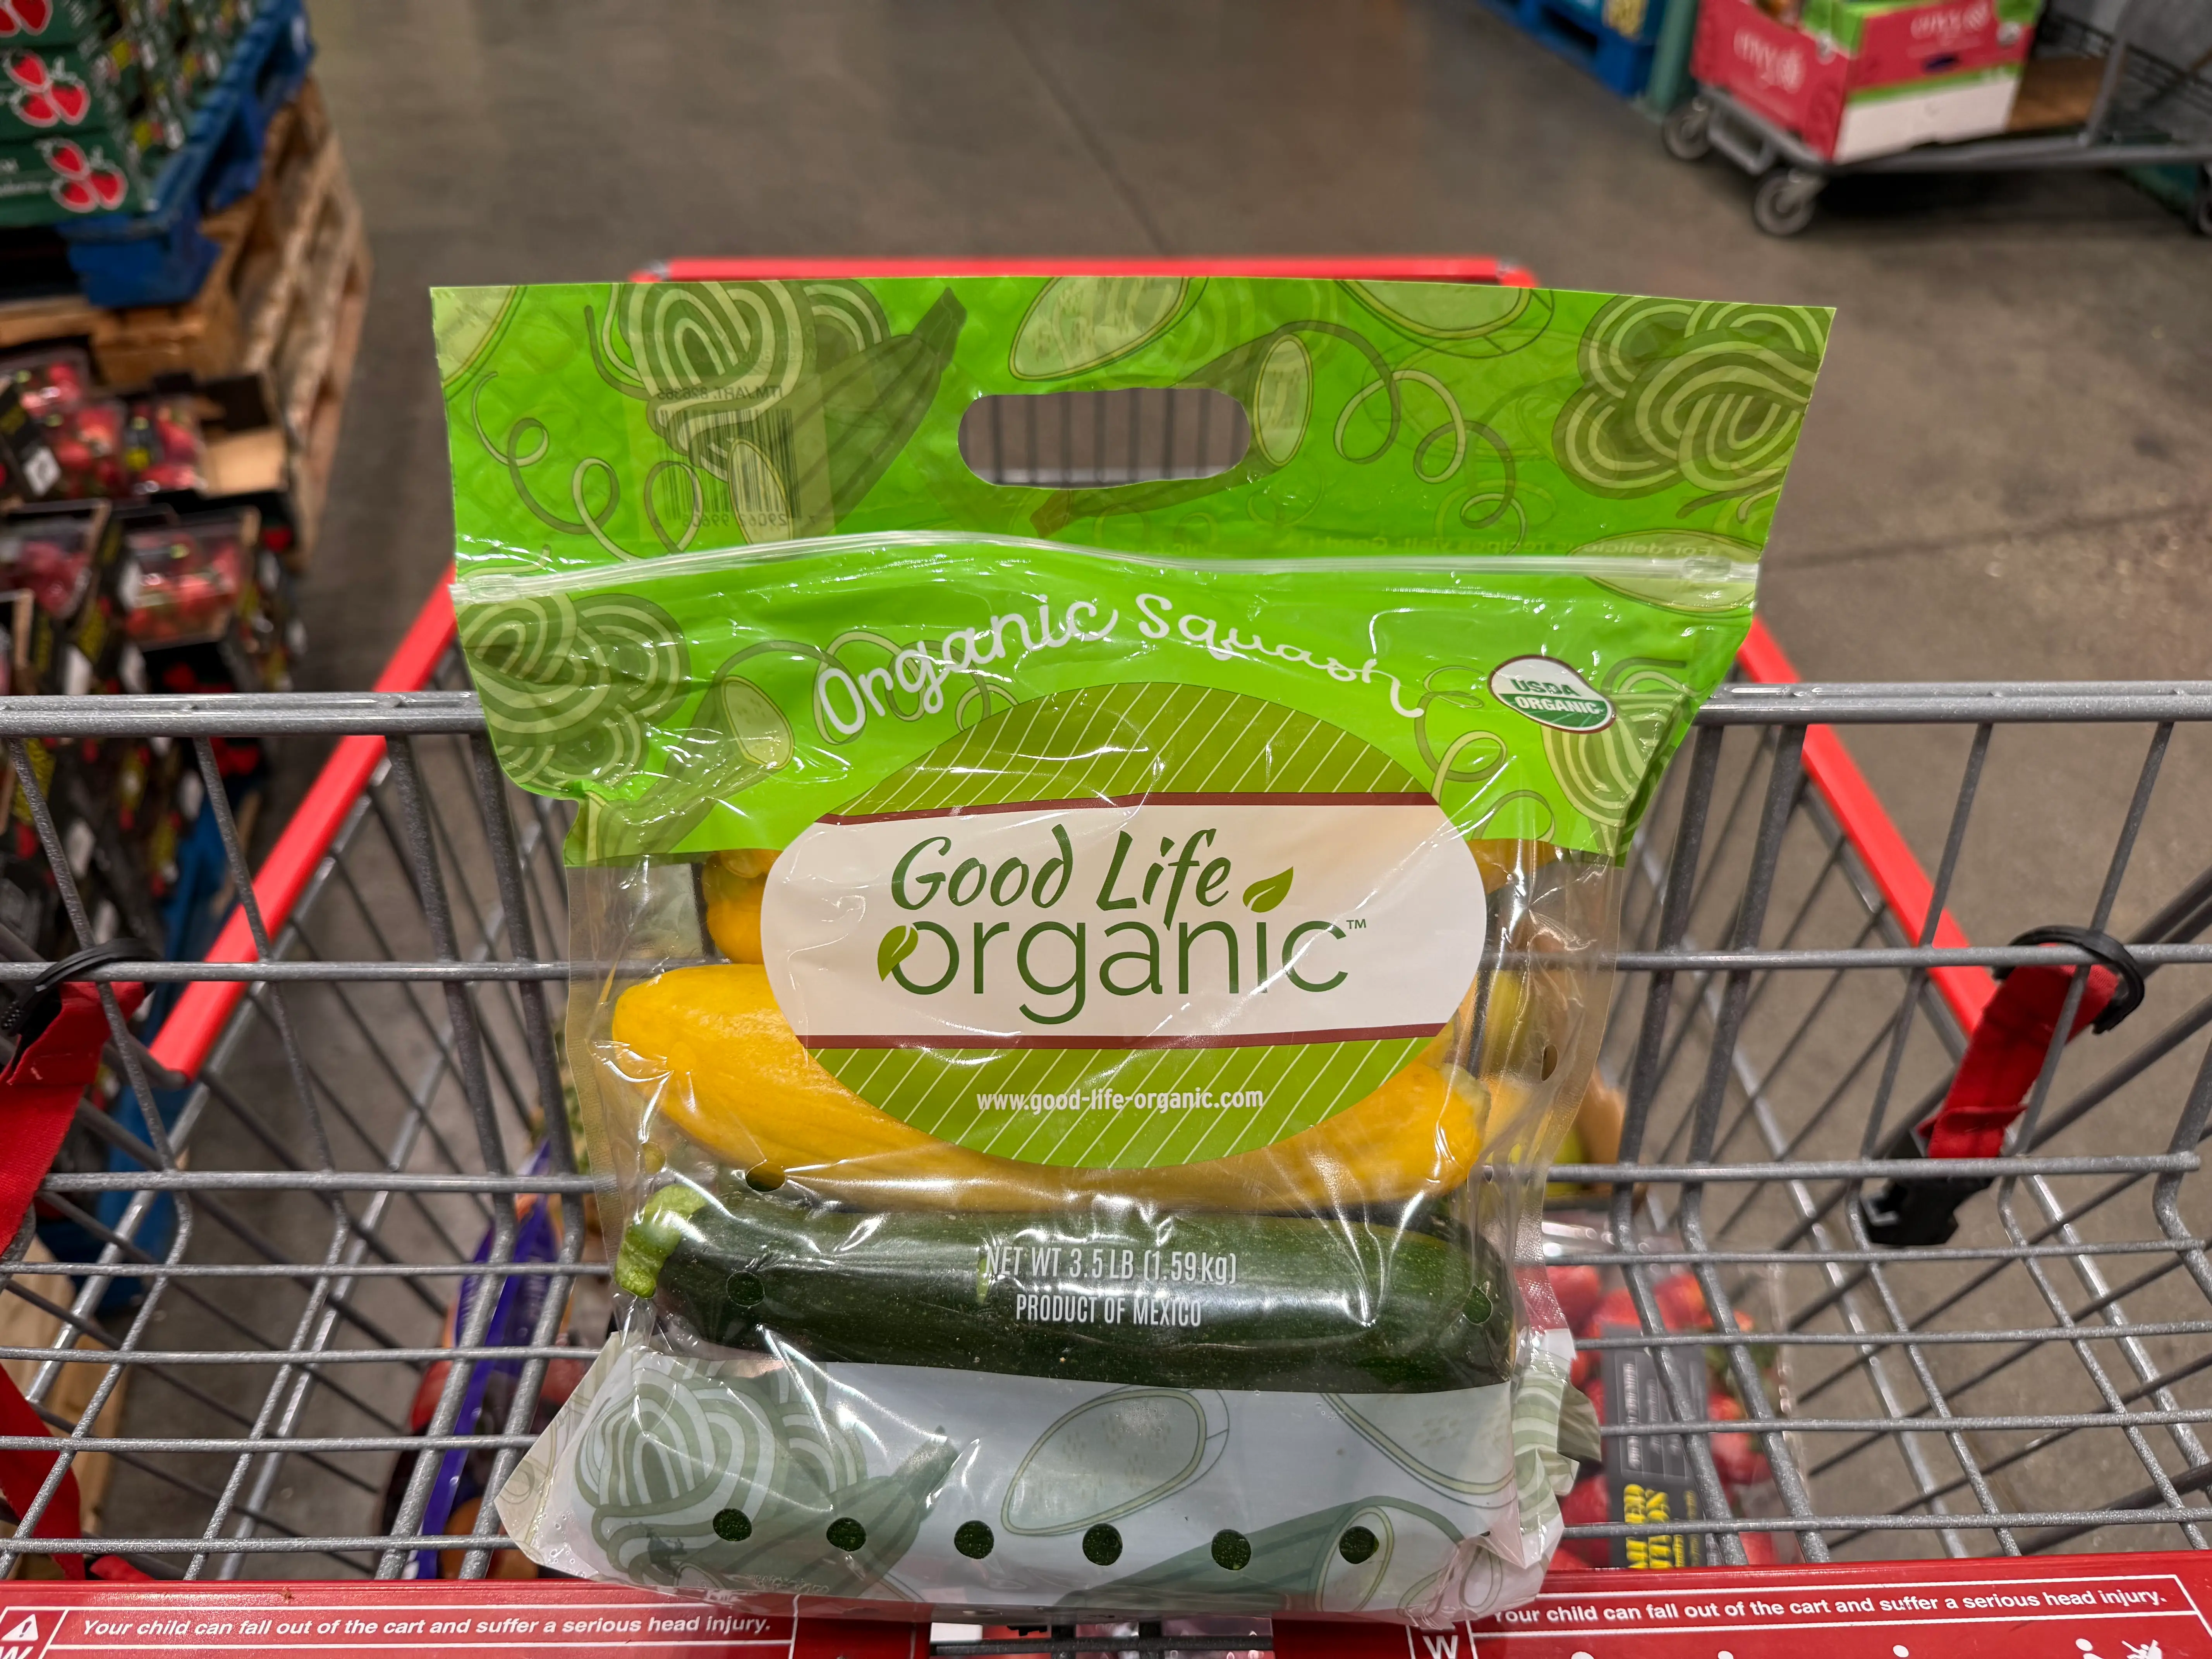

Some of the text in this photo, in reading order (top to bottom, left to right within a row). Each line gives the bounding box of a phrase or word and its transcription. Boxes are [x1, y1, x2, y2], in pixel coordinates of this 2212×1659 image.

[818, 593, 1424, 734] Organic Squash
[1510, 679, 1581, 697] USDA
[1515, 696, 1601, 715] ORGANIC
[891, 823, 1231, 931] Good Life
[890, 920, 1348, 1025] organic
[976, 1087, 1264, 1115] www.good-life-organic.com
[986, 1246, 1023, 1276] NET
[1031, 1247, 1062, 1277] WT
[1016, 1293, 1201, 1327] PRODUCT OF MEXICO
[1546, 1606, 1599, 1622] child
[1603, 1607, 1642, 1620] can
[1645, 1603, 1679, 1619] fall
[1684, 1603, 1721, 1618] out
[1724, 1601, 1745, 1617] of
[1749, 1601, 1784, 1616] the
[1789, 1599, 1831, 1614] cart
[1835, 1597, 1875, 1613] and
[1879, 1596, 1938, 1611] suffer
[1944, 1598, 1959, 1609] a
[1962, 1593, 2040, 1609] serious
[2042, 1590, 2097, 1606] head
[2097, 1589, 2167, 1607] injury.
[84, 1616, 771, 1635] Your child can fall out of the cart and suffer a serious head injury.
